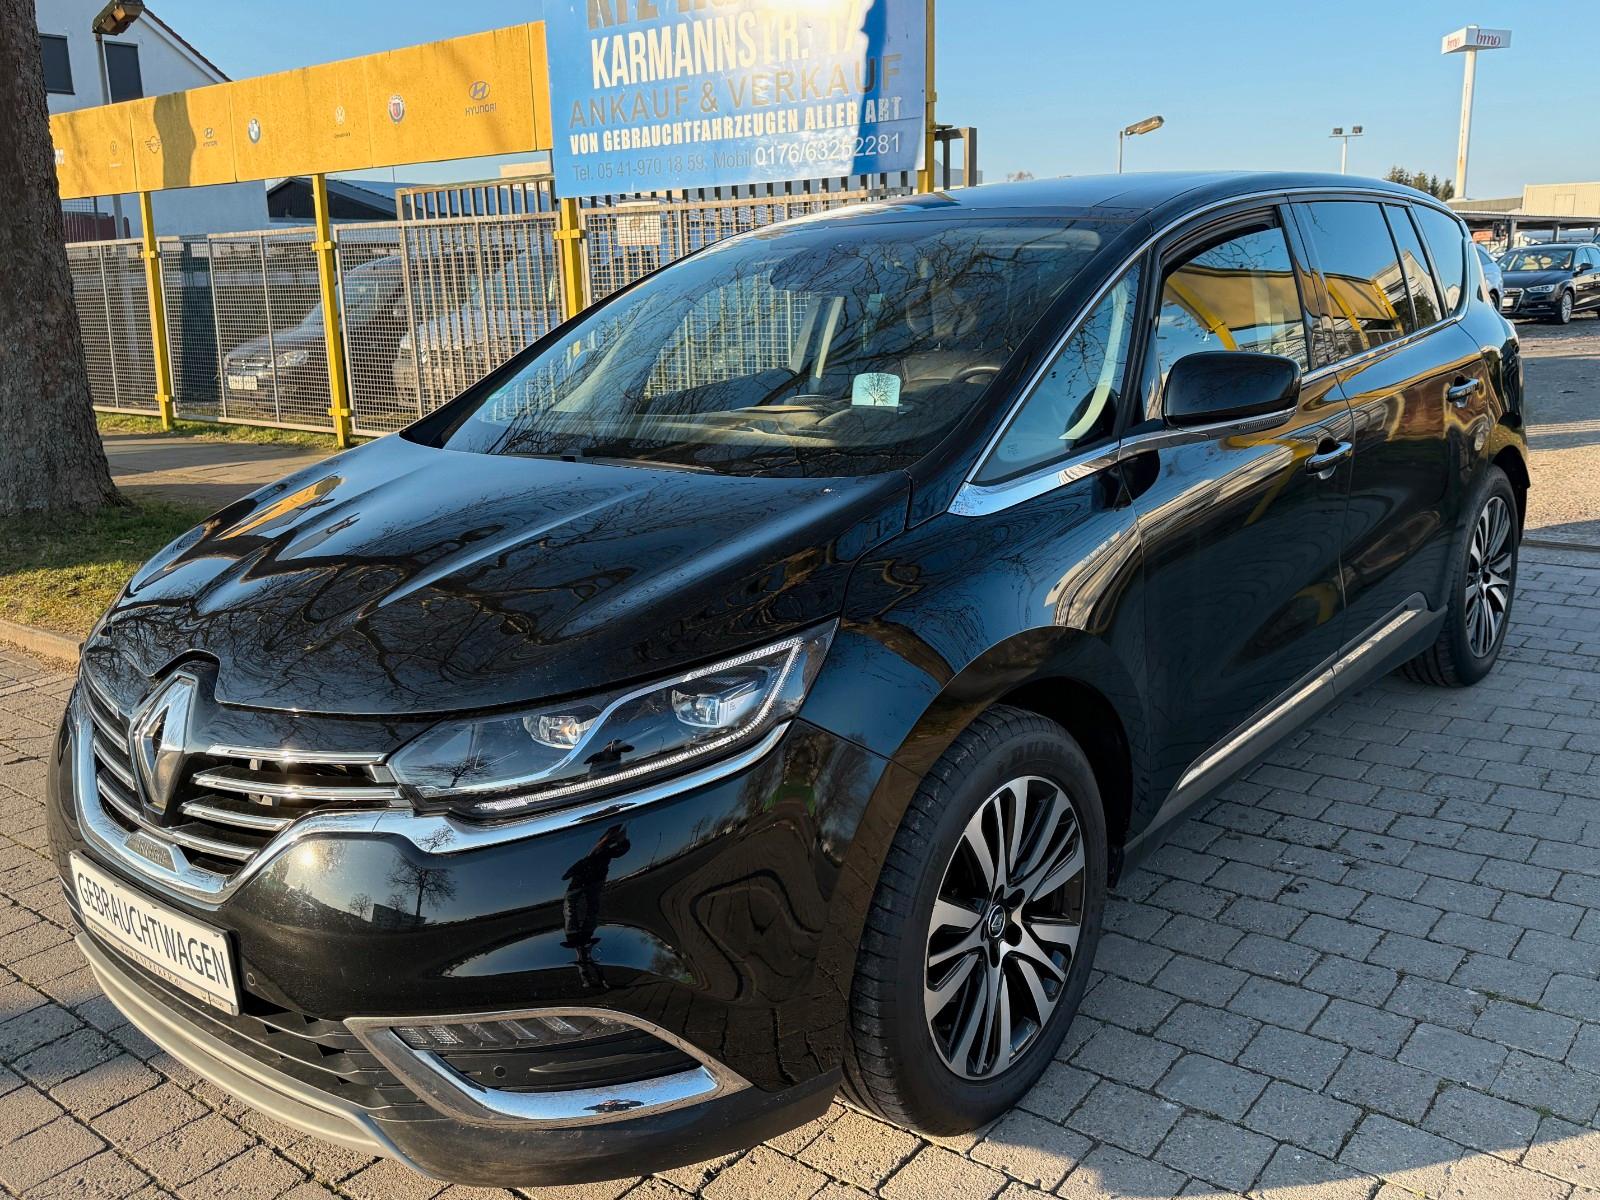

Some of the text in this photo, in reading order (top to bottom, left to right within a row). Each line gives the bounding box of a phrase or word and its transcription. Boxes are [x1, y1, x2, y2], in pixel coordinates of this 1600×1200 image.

[591, 8, 809, 89] KARMANNSTR.
[465, 102, 497, 117] HYUNDAI
[569, 54, 903, 128] ANKAUF & VERKAUF
[570, 96, 903, 155] VON GEBRAUCHTFAHRZEUGEN ALLER ART
[573, 164, 594, 181] Tel.
[78, 872, 230, 989] GEBRAUCHTWAGEN
